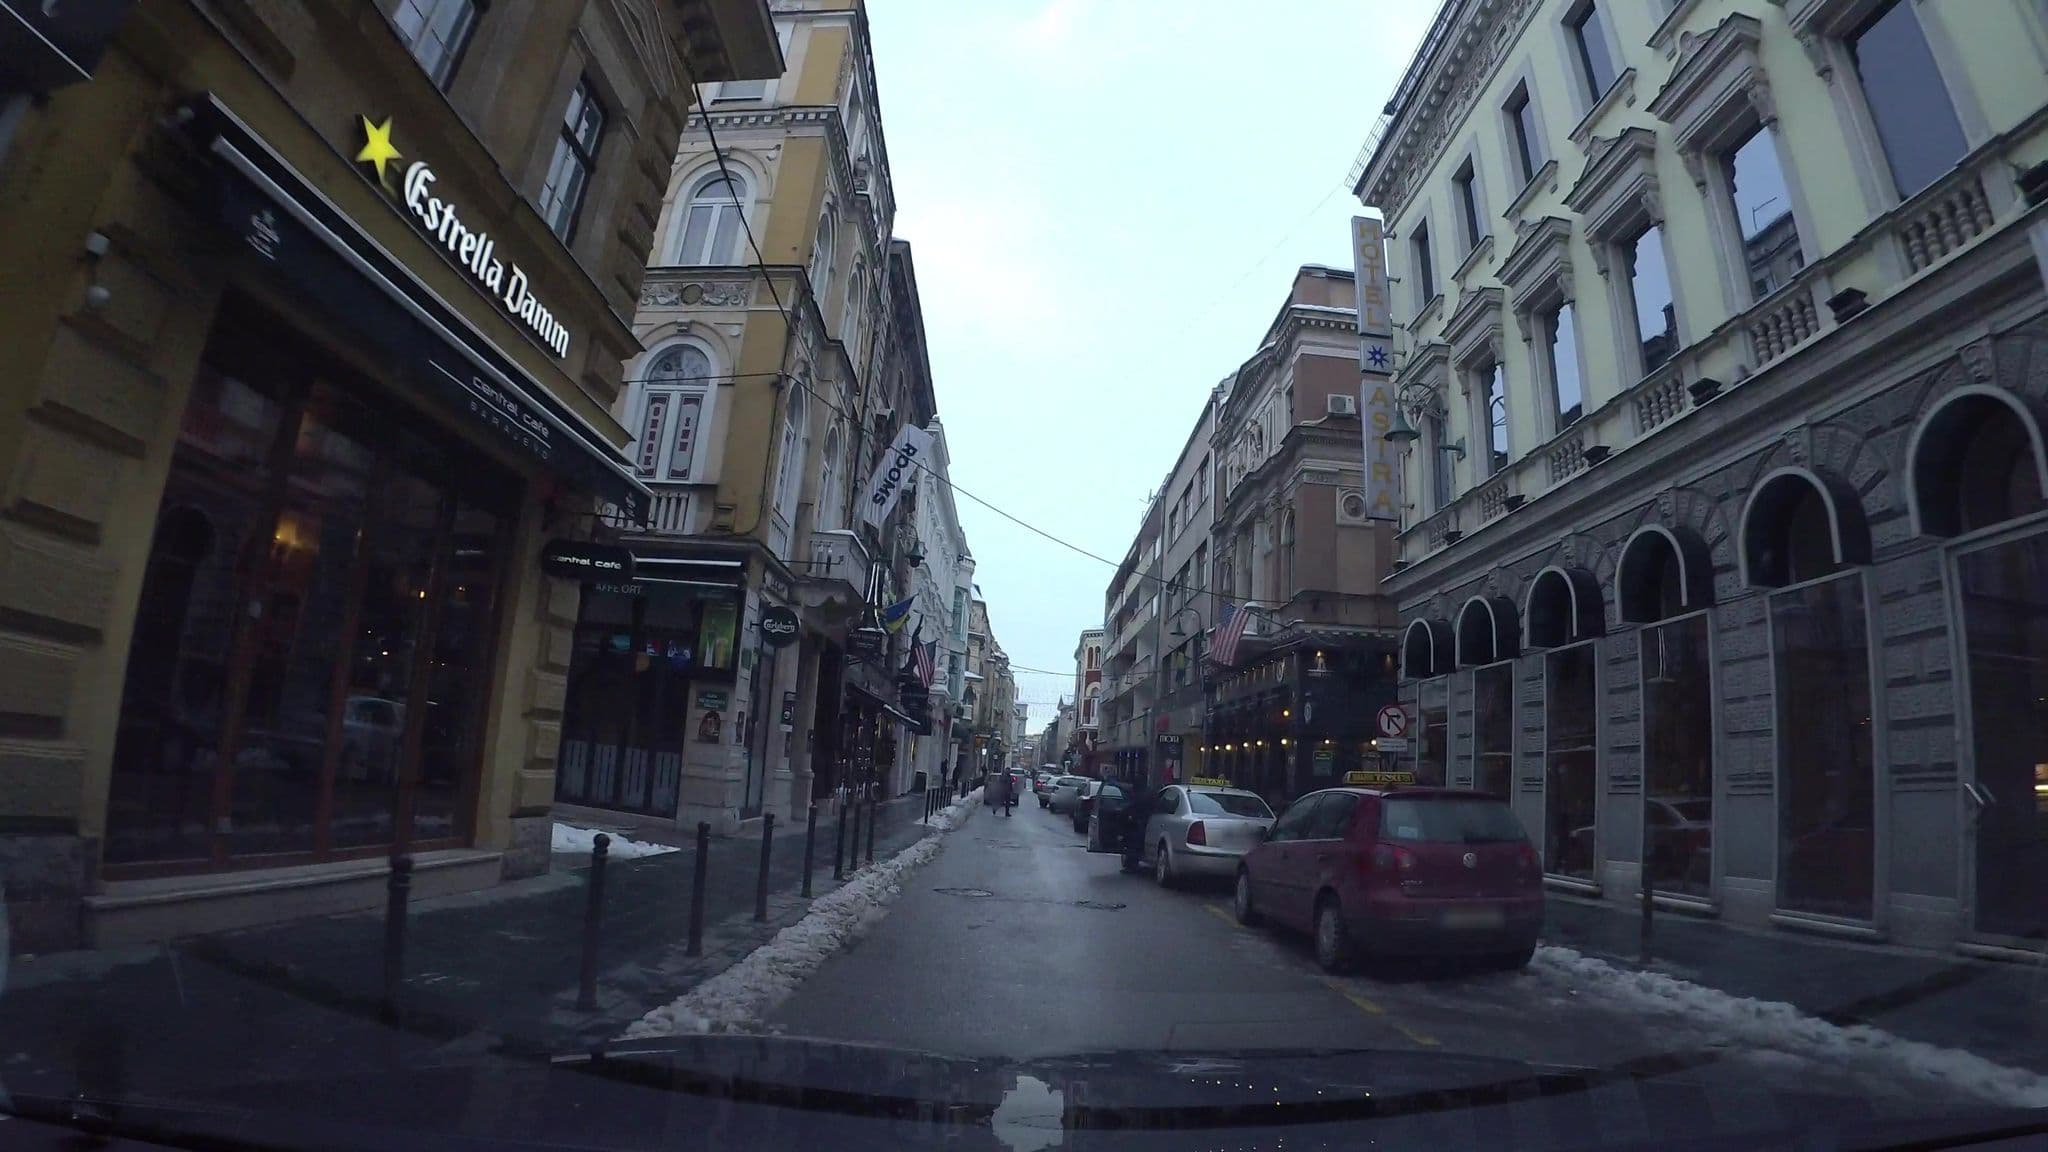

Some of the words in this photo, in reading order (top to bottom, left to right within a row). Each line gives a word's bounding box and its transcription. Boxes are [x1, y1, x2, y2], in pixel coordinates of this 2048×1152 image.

[404, 161, 503, 295] Estrella
[504, 262, 569, 359] Damm
[1359, 223, 1384, 327] HOTEL
[472, 375, 518, 417] central
[872, 443, 918, 506] ROOMS
[1368, 386, 1395, 512] ASTRA
[763, 618, 795, 634] Carlsberg
